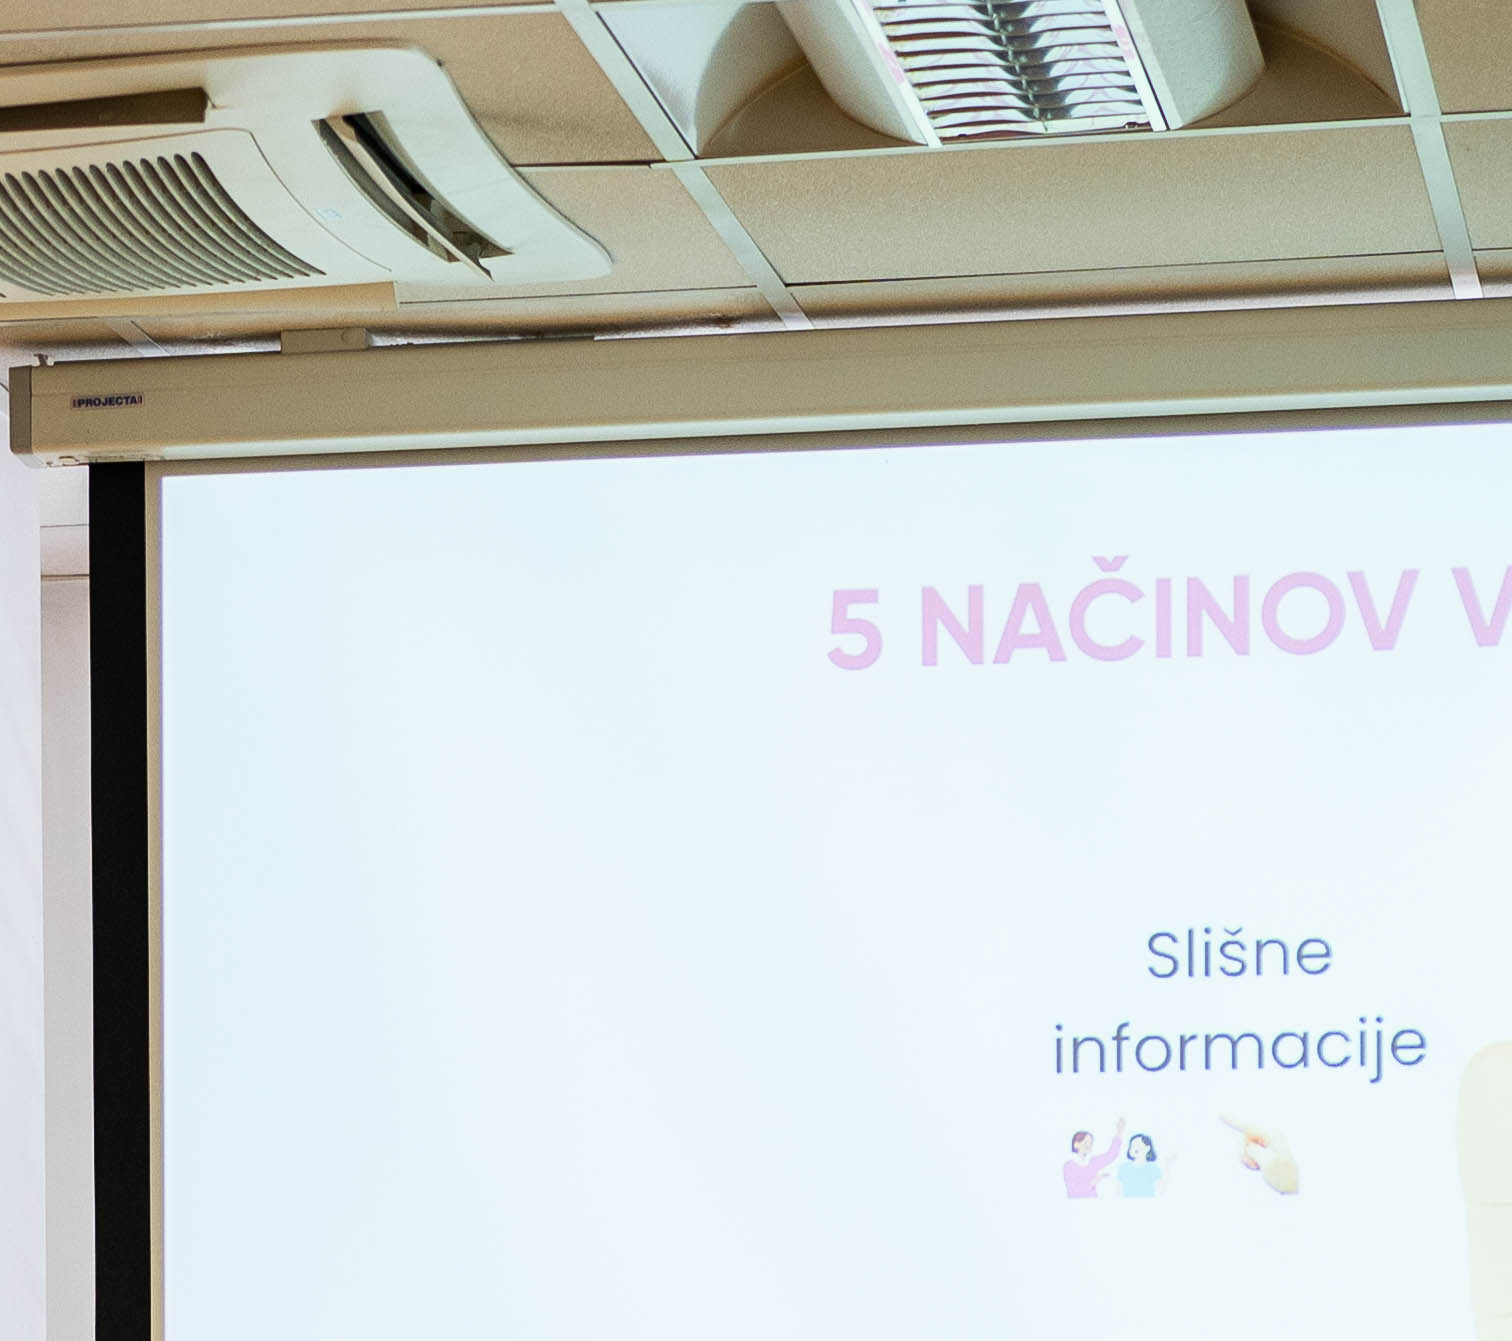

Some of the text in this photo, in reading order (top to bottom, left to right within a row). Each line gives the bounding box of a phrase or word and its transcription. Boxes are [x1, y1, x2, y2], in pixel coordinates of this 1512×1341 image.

[78, 395, 137, 408] PROJECTA
[826, 588, 883, 670] 5
[921, 555, 1420, 667] NAČINOV
[1146, 926, 1333, 980] Slišne
[1054, 1015, 1428, 1084] informacije
